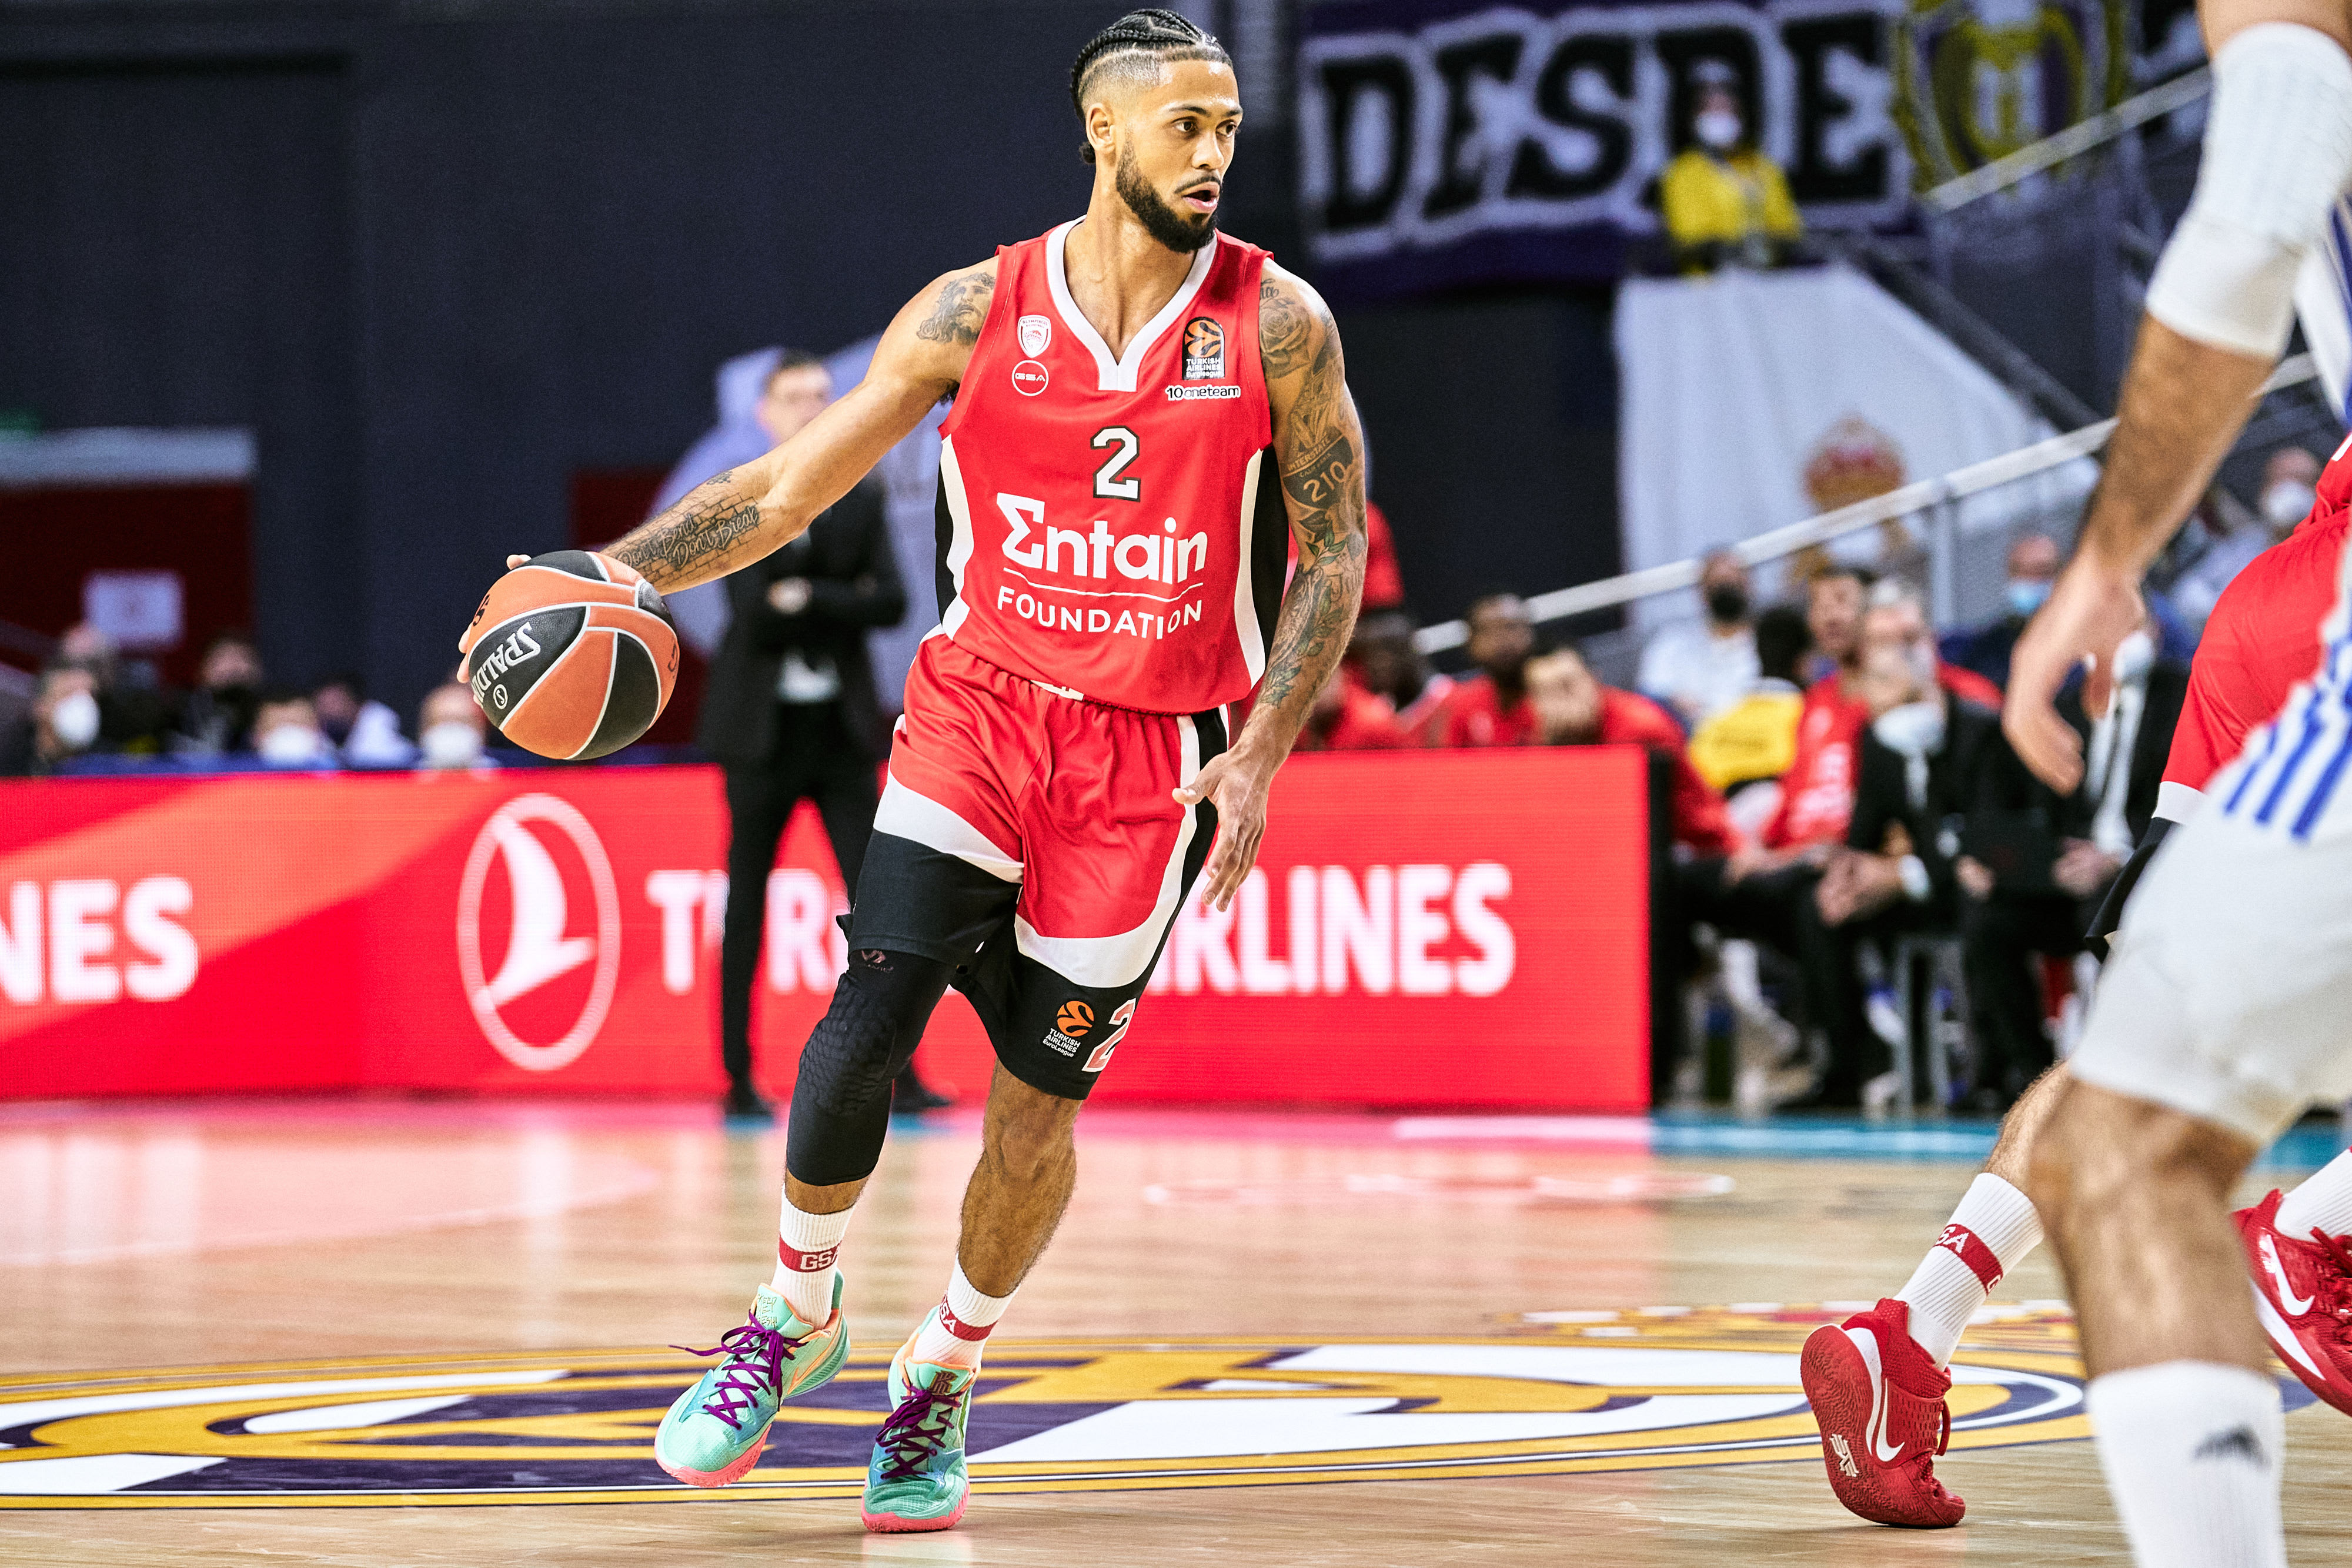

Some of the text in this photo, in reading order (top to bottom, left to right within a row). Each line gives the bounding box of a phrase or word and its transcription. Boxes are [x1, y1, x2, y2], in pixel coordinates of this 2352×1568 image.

[1015, 373, 1046, 382] GSA
[1090, 425, 1141, 502] 2
[1303, 460, 1347, 503] 210
[715, 506, 759, 550] Break
[997, 586, 1203, 641] FOUNDATION
[1147, 862, 1515, 996] RLINES
[1045, 1034, 1078, 1053] AIRLINES
[1050, 1028, 1081, 1048] TURKISH
[1081, 998, 1137, 1072] 2
[940, 1291, 957, 1335] SA
